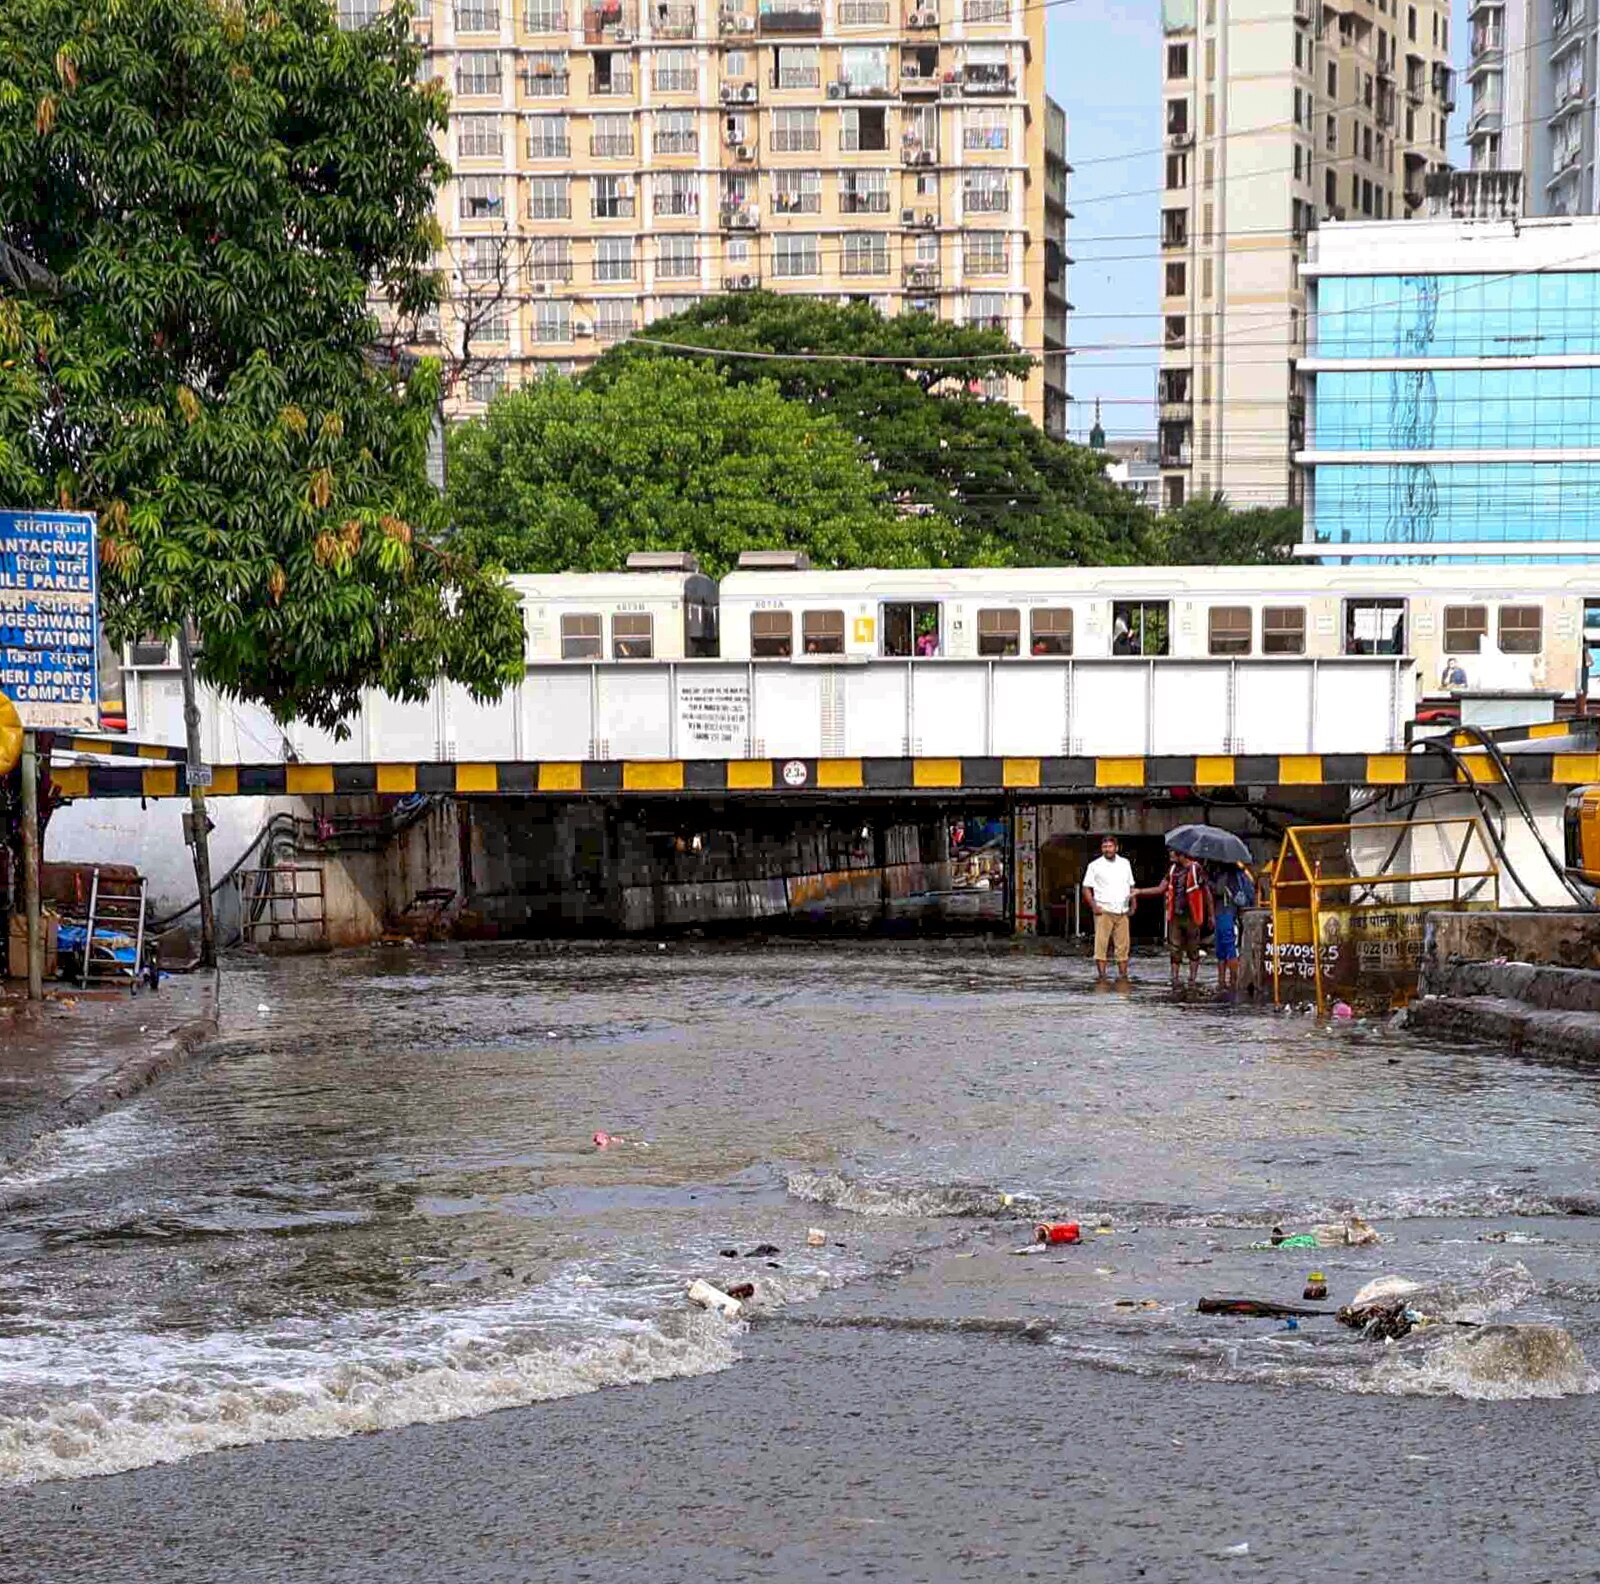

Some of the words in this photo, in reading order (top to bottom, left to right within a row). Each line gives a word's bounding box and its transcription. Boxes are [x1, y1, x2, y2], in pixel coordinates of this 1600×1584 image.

[33, 574, 90, 590] PARLE
[24, 630, 90, 646] STATION
[34, 671, 92, 685] SPORTS
[16, 685, 92, 702] COMPLEX
